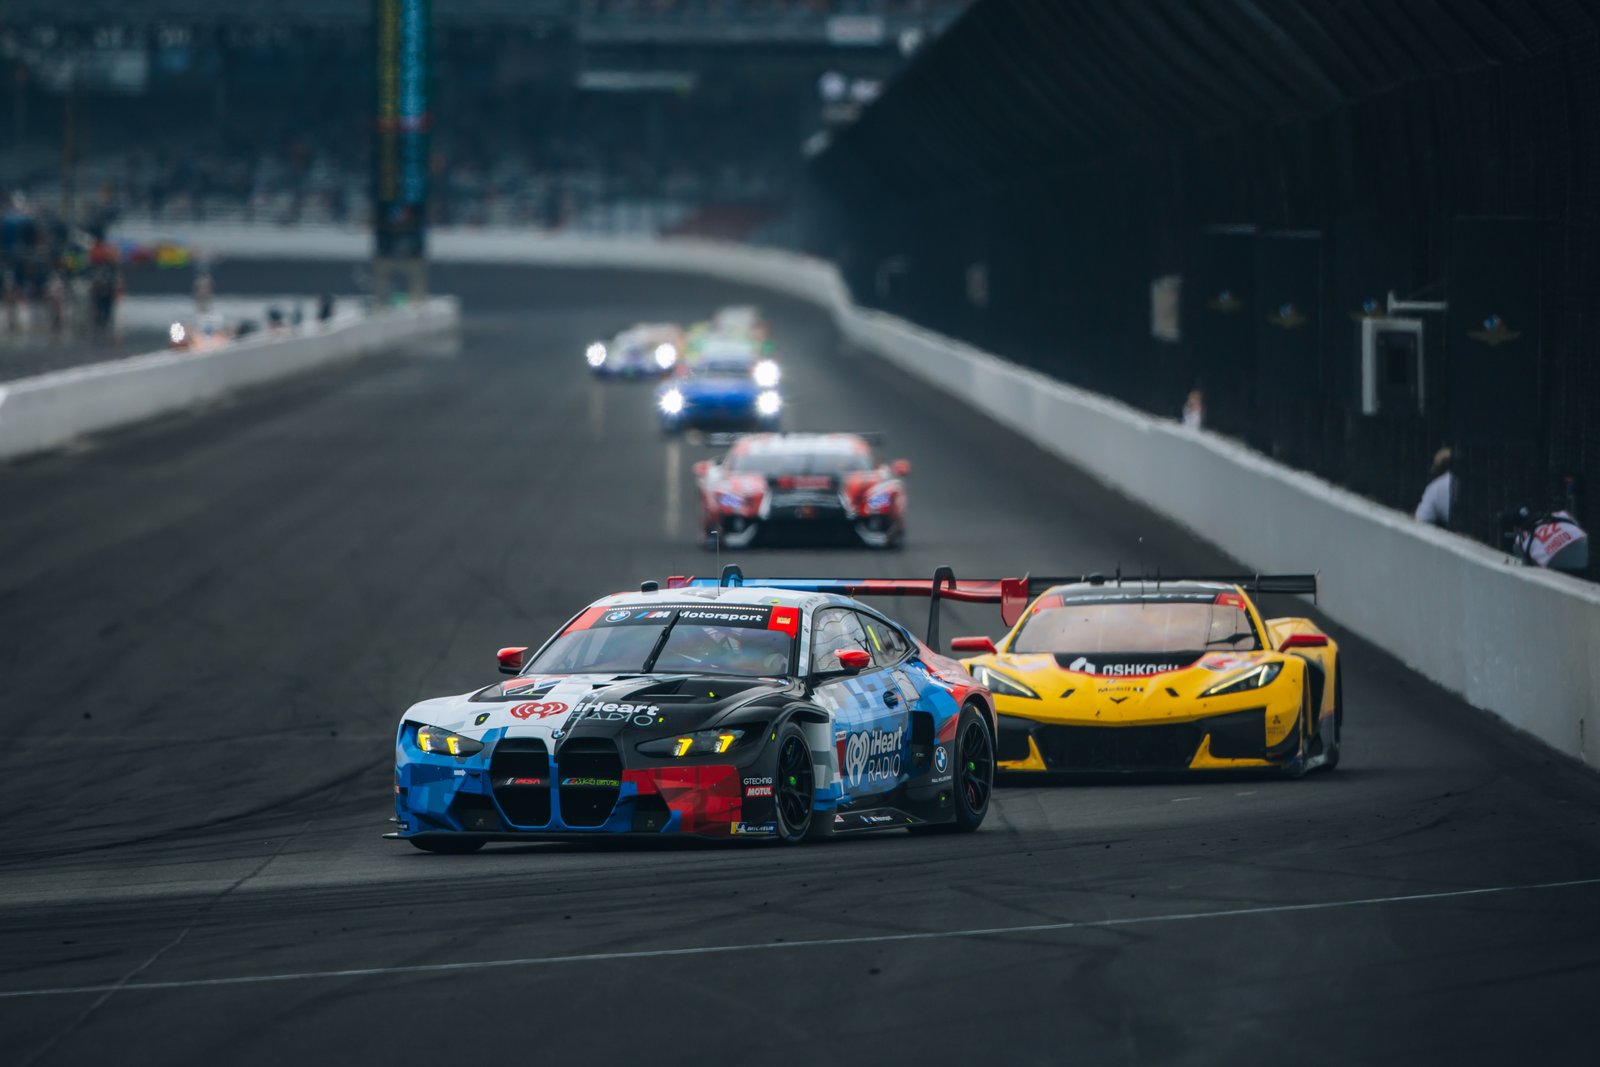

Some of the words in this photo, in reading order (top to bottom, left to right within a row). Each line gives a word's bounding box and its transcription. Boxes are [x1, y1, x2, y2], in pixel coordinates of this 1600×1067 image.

[679, 610, 763, 622] Motorsport
[573, 701, 660, 716] iHeart
[568, 712, 653, 726] RADIO
[870, 726, 903, 757] iHeart
[868, 753, 900, 783] RADIO
[746, 787, 771, 796] MOTUL
